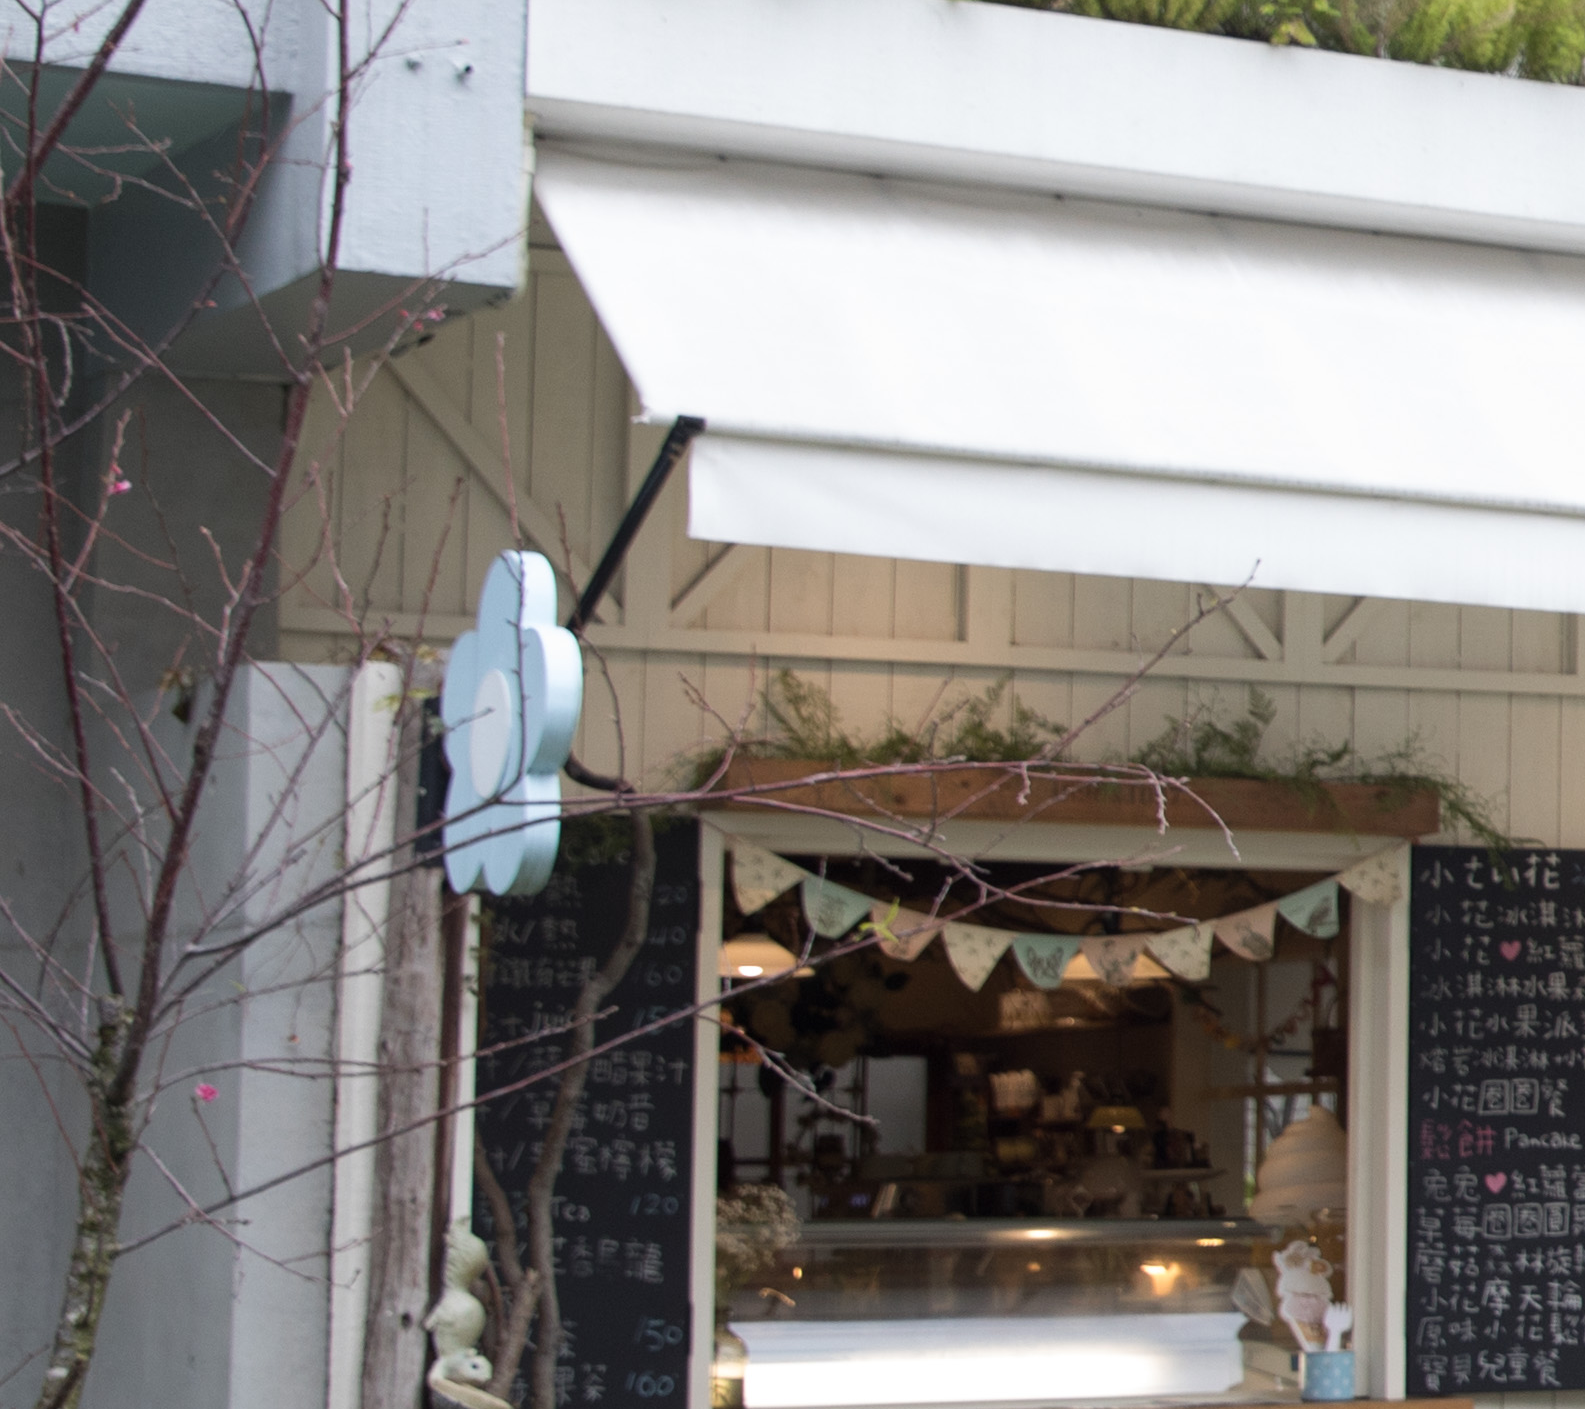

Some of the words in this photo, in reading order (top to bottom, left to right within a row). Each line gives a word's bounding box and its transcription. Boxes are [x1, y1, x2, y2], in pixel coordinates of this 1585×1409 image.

[1504, 1126, 1583, 1150] Pancake
[630, 1193, 680, 1216] 120
[1420, 1278, 1583, 1317] 小花摩天輪
